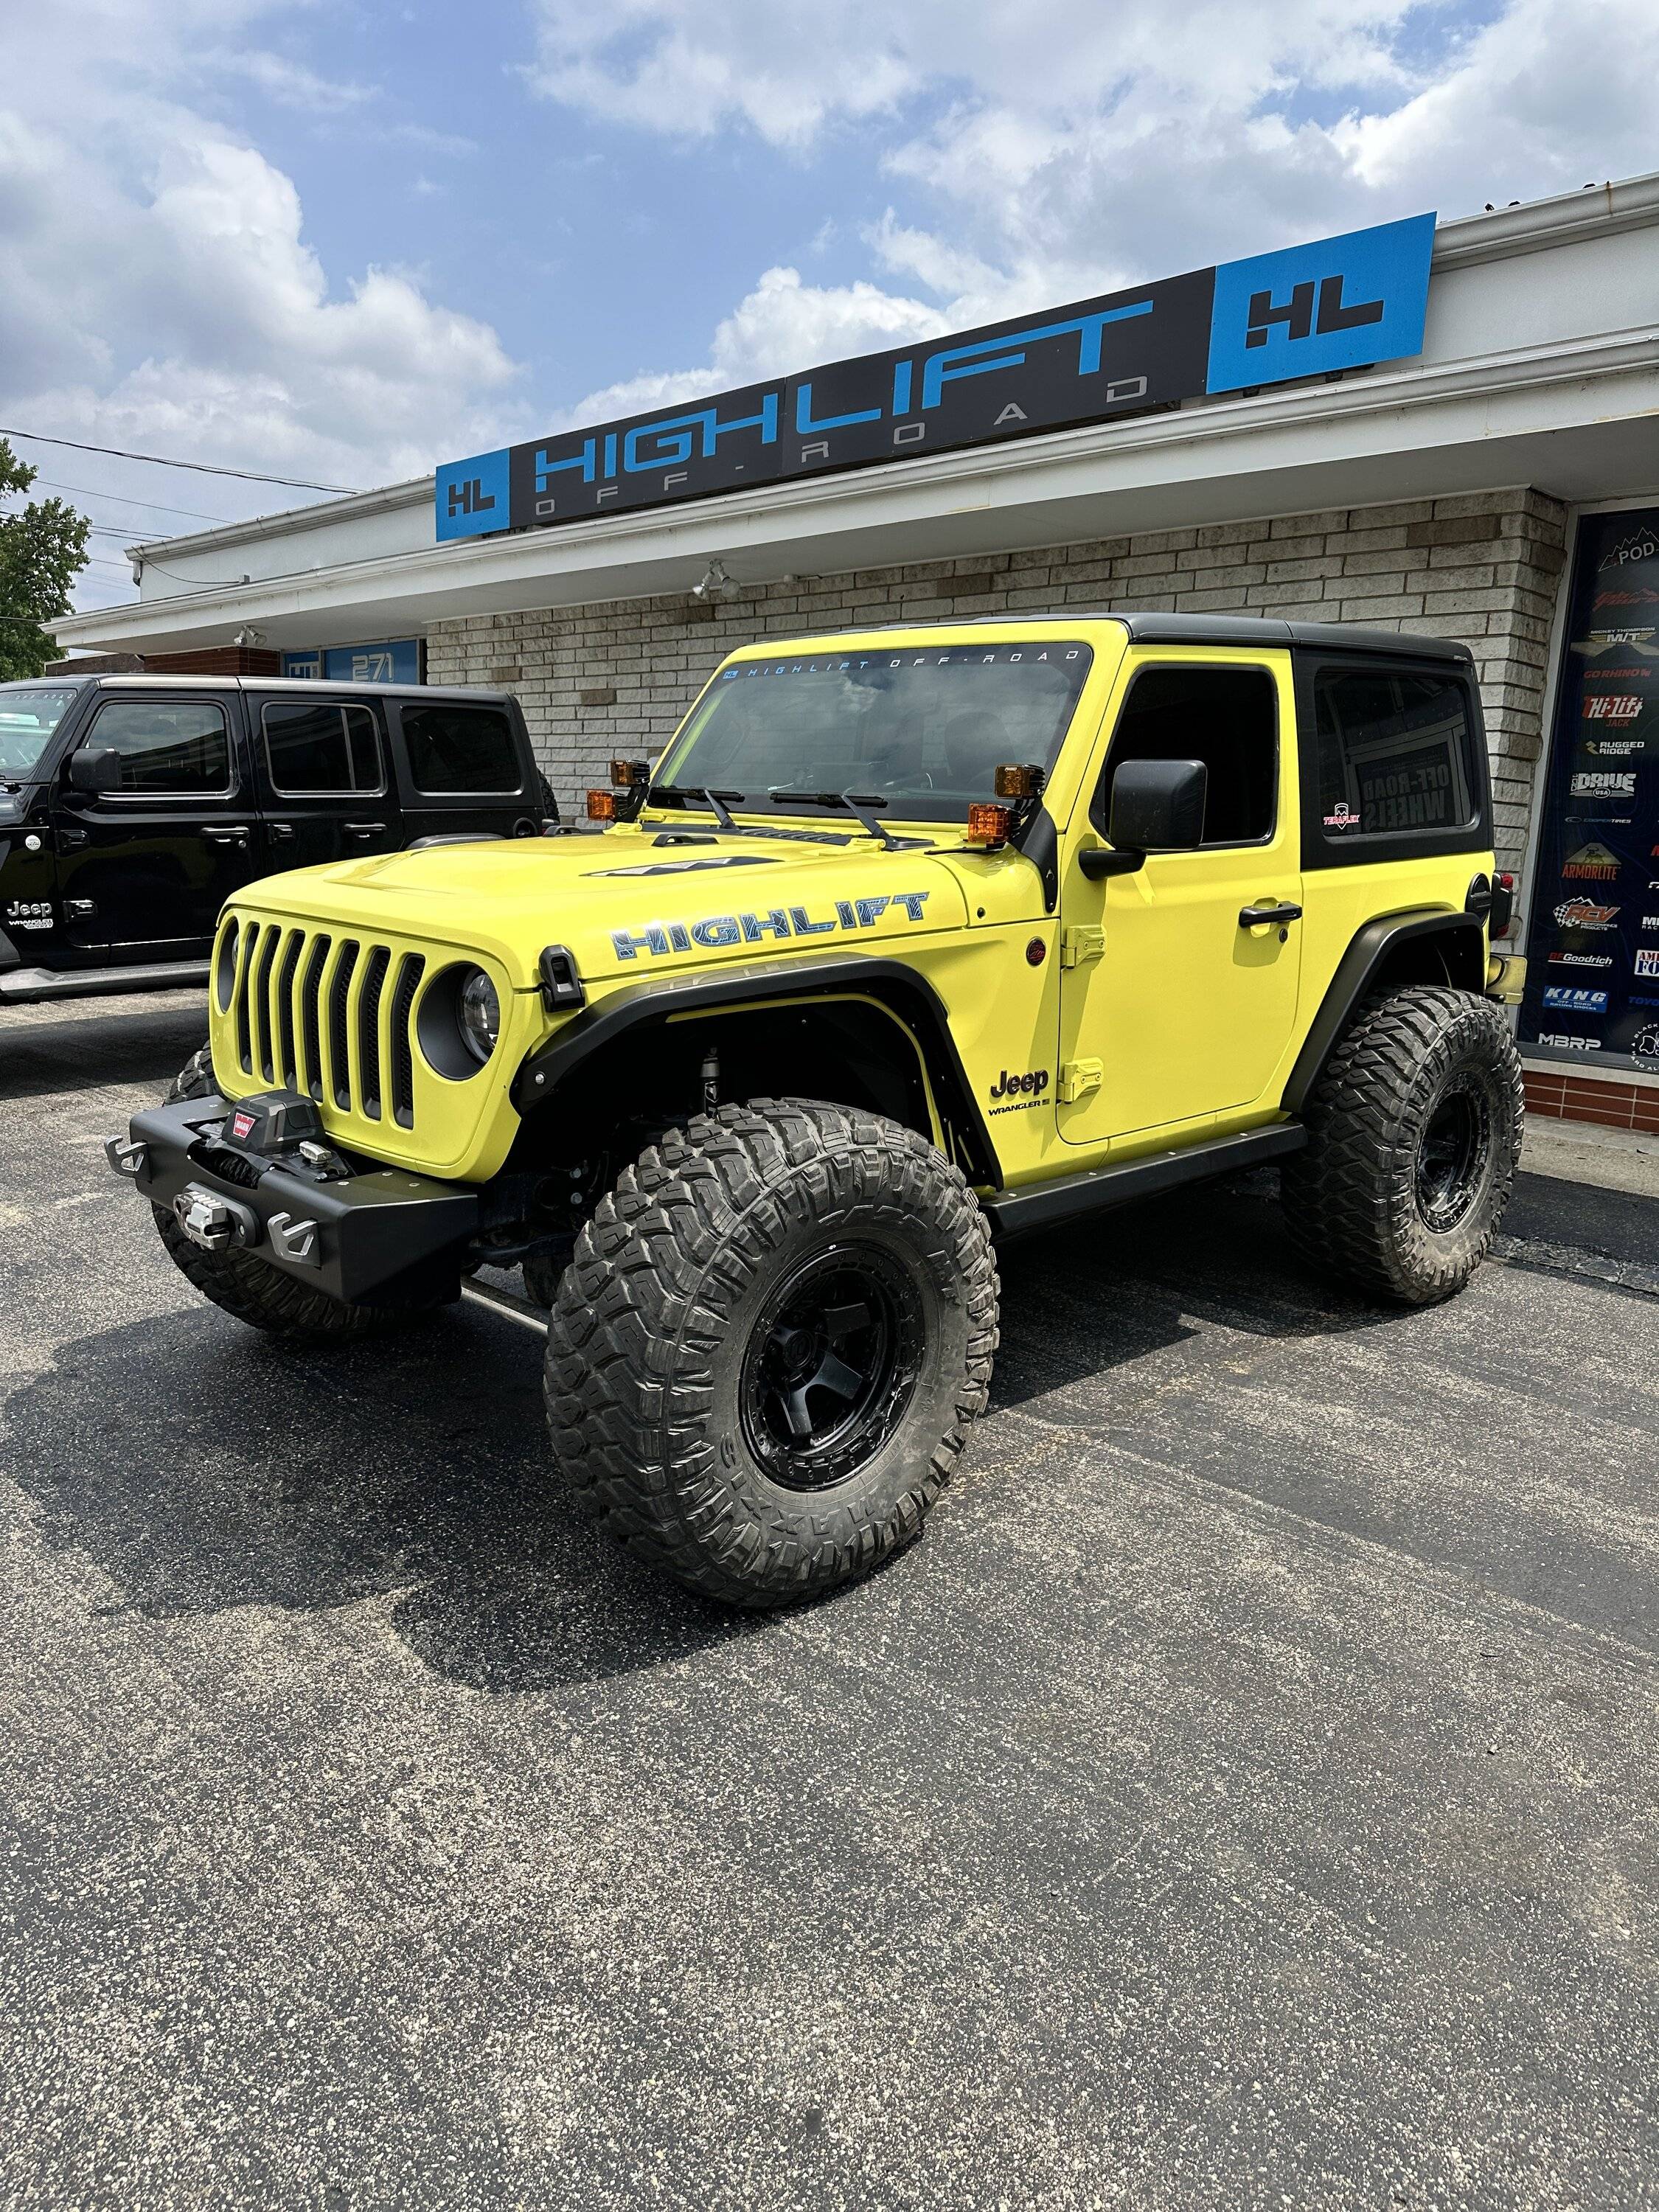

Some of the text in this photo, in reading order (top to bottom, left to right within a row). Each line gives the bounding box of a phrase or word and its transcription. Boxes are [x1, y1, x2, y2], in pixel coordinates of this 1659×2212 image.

[1244, 275, 1384, 348] HL
[535, 299, 1153, 492] HIGHLIFT
[535, 375, 1149, 518] OFF-ROAD
[448, 477, 495, 518] HL
[1607, 632, 1641, 642] M/T
[352, 652, 394, 683] 271
[747, 661, 869, 677] HIGHLIFT
[1605, 718, 1630, 728] JACK
[1576, 773, 1637, 793] DRIVE
[1561, 864, 1618, 880] ARMORLITE
[7, 900, 52, 917] Jeep
[1562, 904, 1621, 923] RCV
[610, 891, 931, 962] HIGHLIFT
[1549, 952, 1613, 965] BFGoodrich
[1545, 987, 1607, 1003] KING
[1538, 1032, 1601, 1050] MBRP
[990, 1069, 1048, 1098] Jeep
[988, 1100, 1041, 1116] WRANGLER
